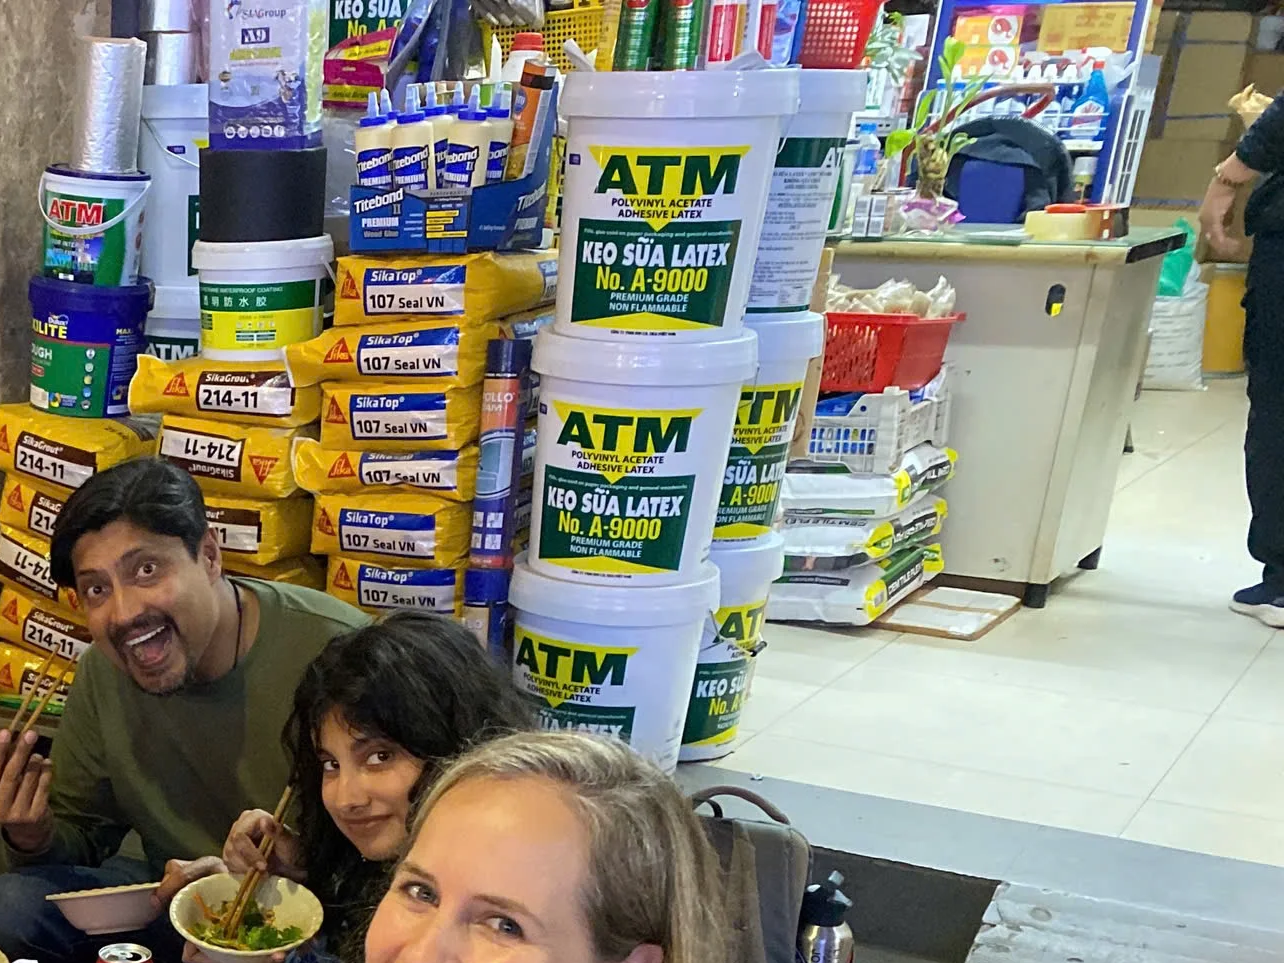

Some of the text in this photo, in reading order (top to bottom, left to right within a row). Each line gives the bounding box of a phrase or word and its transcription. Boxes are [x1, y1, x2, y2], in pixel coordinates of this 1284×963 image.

[595, 154, 742, 196] ATM
[354, 188, 404, 214] Titebond
[611, 197, 713, 208] POLYVINYL ACETATE
[48, 197, 104, 225] ATM
[617, 209, 703, 219] ADHESIVE LATEX
[362, 217, 399, 228] PREMIUM
[582, 240, 618, 266] KEO
[670, 242, 731, 268] LATEX
[596, 265, 709, 293] No. A-9000
[369, 294, 445, 309] 107 Seal VN
[609, 302, 688, 313] NON FLAMMABLE
[610, 293, 690, 304] PREMIUM GRADE
[363, 356, 441, 371] 107 Seal VN
[202, 389, 258, 409] 214-11
[735, 388, 803, 425] TM
[356, 420, 428, 434] 107 Seal VN
[556, 410, 693, 454] ATM
[184, 437, 237, 463] 214-11
[571, 450, 665, 465] POLYVINYL ACETATE
[19, 450, 65, 480] 214-11
[576, 461, 655, 474] ADHESIVE LATEX
[365, 470, 391, 484] 107
[422, 472, 441, 484] VN
[547, 485, 577, 512] KEO
[625, 495, 685, 518] LATEX
[558, 510, 662, 540] No. A-9000
[345, 533, 416, 552] 107 Seal VN
[569, 544, 642, 558] NON FLAMMABLE
[570, 535, 644, 549] PREMIUM GRADE
[363, 588, 436, 608] 107 Seal VN
[27, 624, 74, 656] 214-11
[515, 635, 629, 687] ATM
[562, 684, 601, 695] ACETATE
[564, 693, 592, 703] LATEX
[695, 678, 729, 699] KEO
